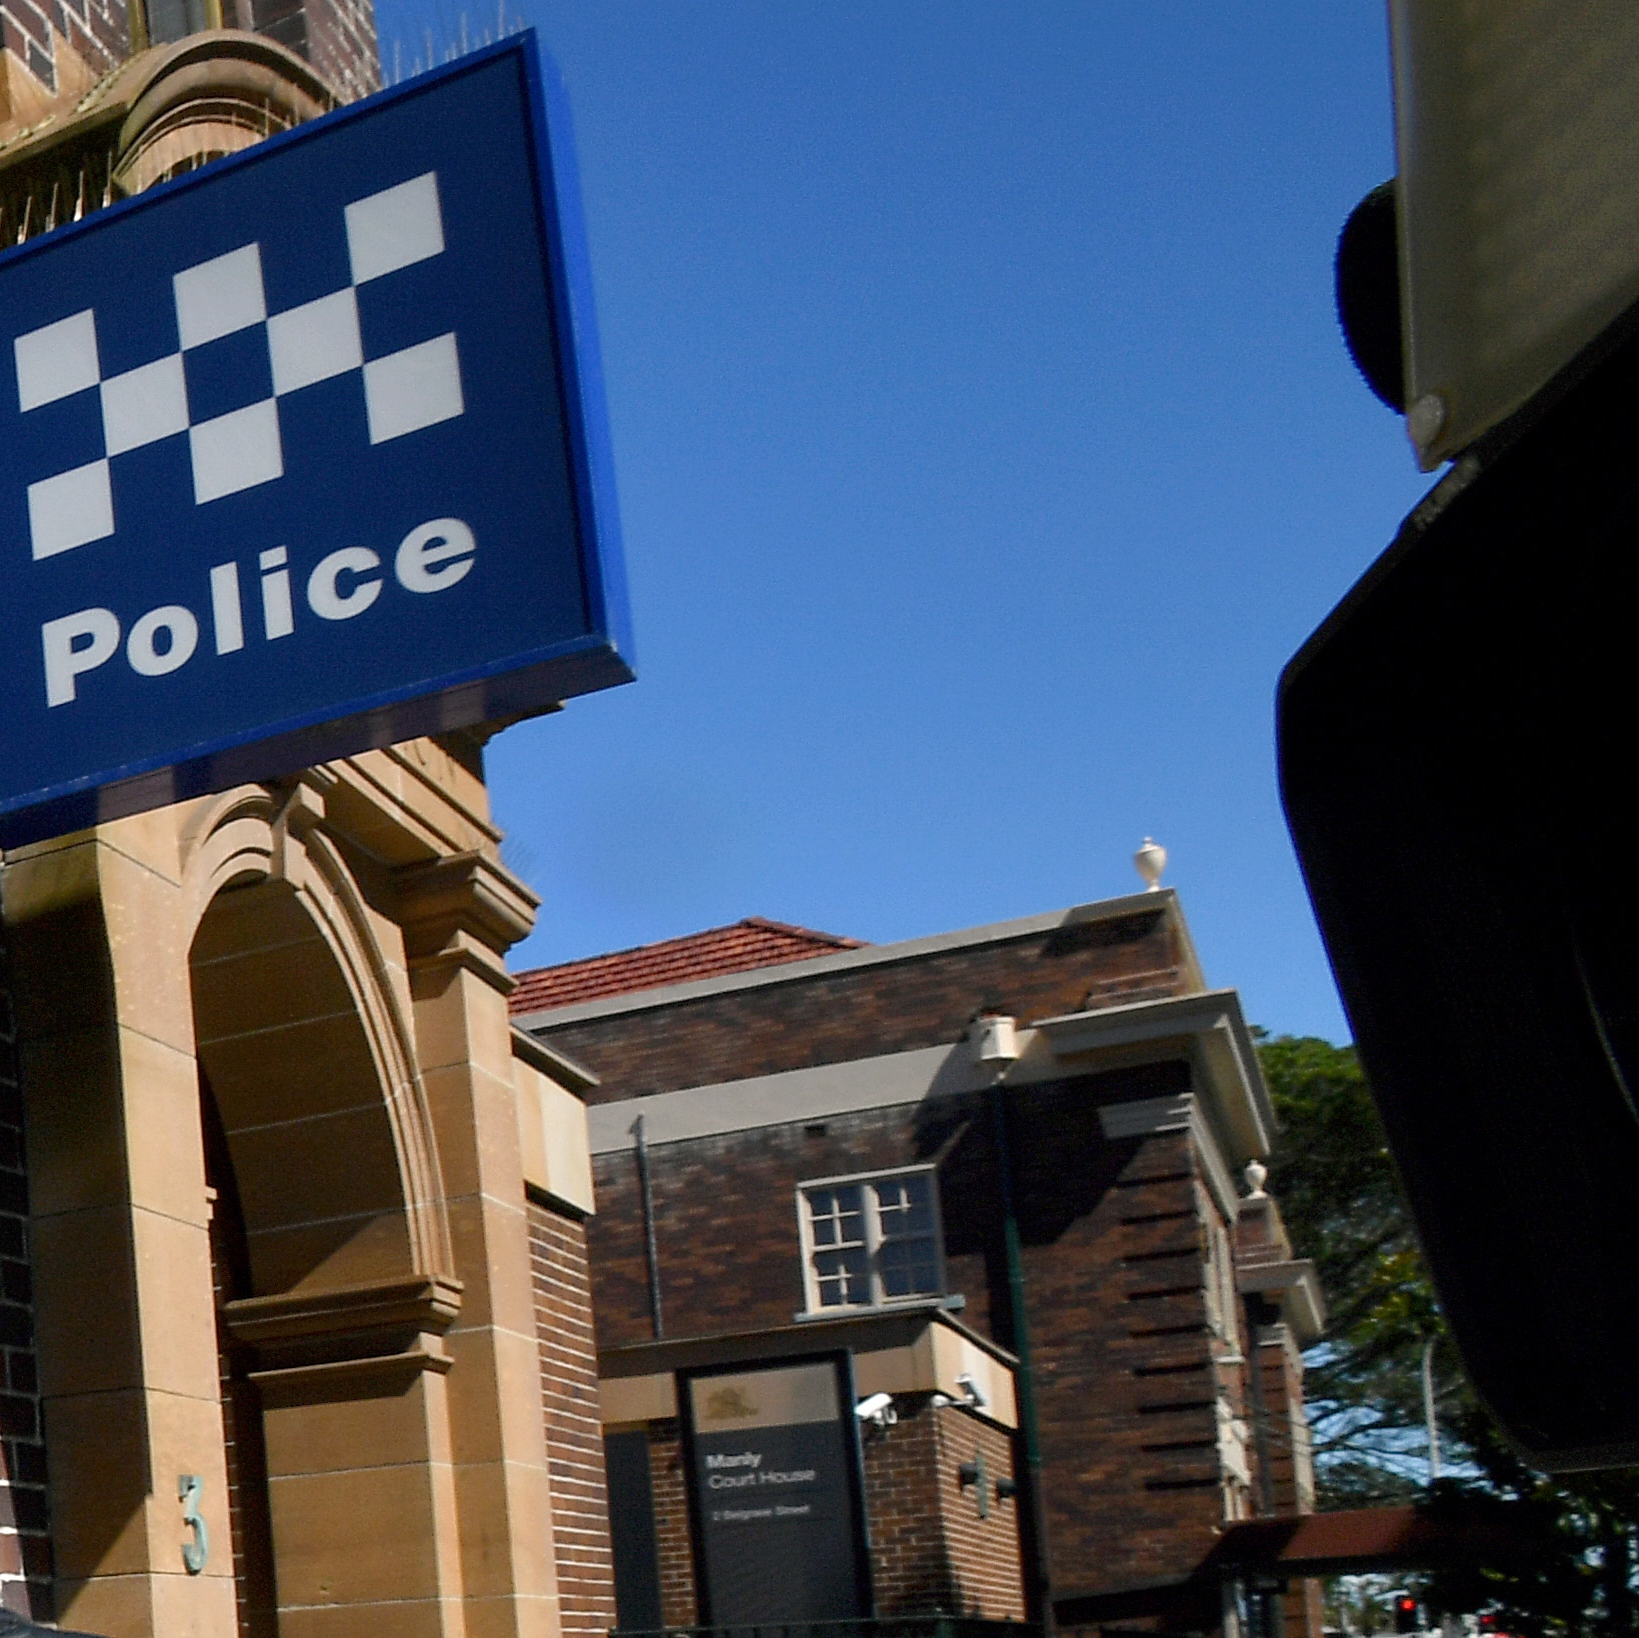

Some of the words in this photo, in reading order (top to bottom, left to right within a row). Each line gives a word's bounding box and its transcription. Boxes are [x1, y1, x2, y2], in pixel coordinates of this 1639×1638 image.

[41, 516, 477, 708] Police
[706, 1451, 762, 1469] Manly
[709, 1472, 757, 1489] Court
[760, 1469, 816, 1484] House
